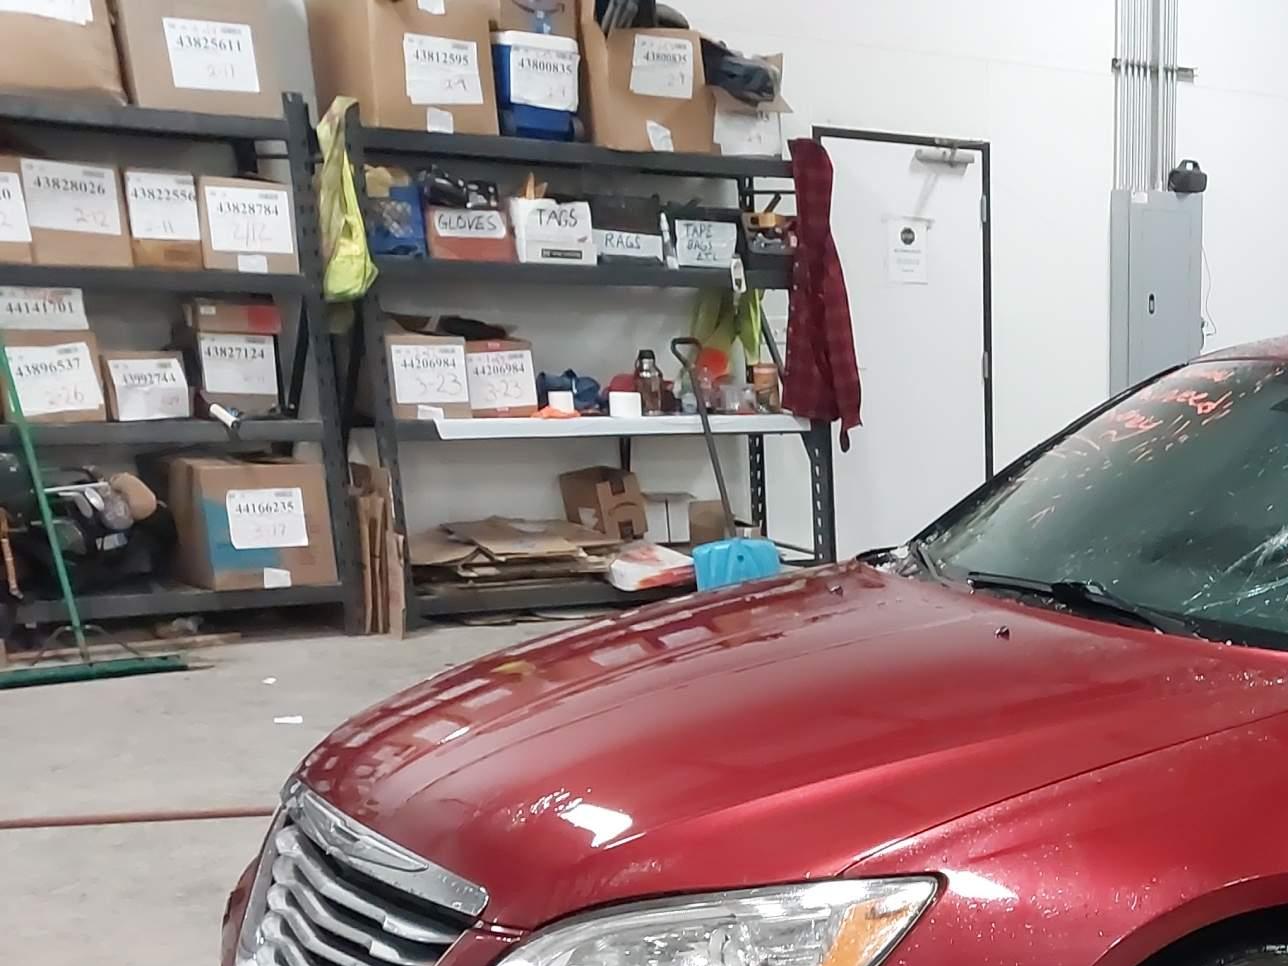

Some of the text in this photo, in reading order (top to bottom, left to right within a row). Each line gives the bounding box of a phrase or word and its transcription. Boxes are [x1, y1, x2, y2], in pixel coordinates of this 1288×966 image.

[176, 34, 242, 53] 43825611
[413, 48, 469, 67] 43812595
[33, 175, 106, 196] 43828026
[217, 200, 280, 217] 43828784
[438, 213, 497, 232] GLOVES
[537, 207, 578, 228] TAGS
[683, 223, 713, 240] TAPE
[604, 233, 641, 250] RAGS
[205, 345, 266, 360] 43827124
[15, 356, 81, 378] 43896537
[401, 356, 457, 370] 44206984
[473, 363, 526, 377] 44206984
[235, 501, 295, 514] 44166235
